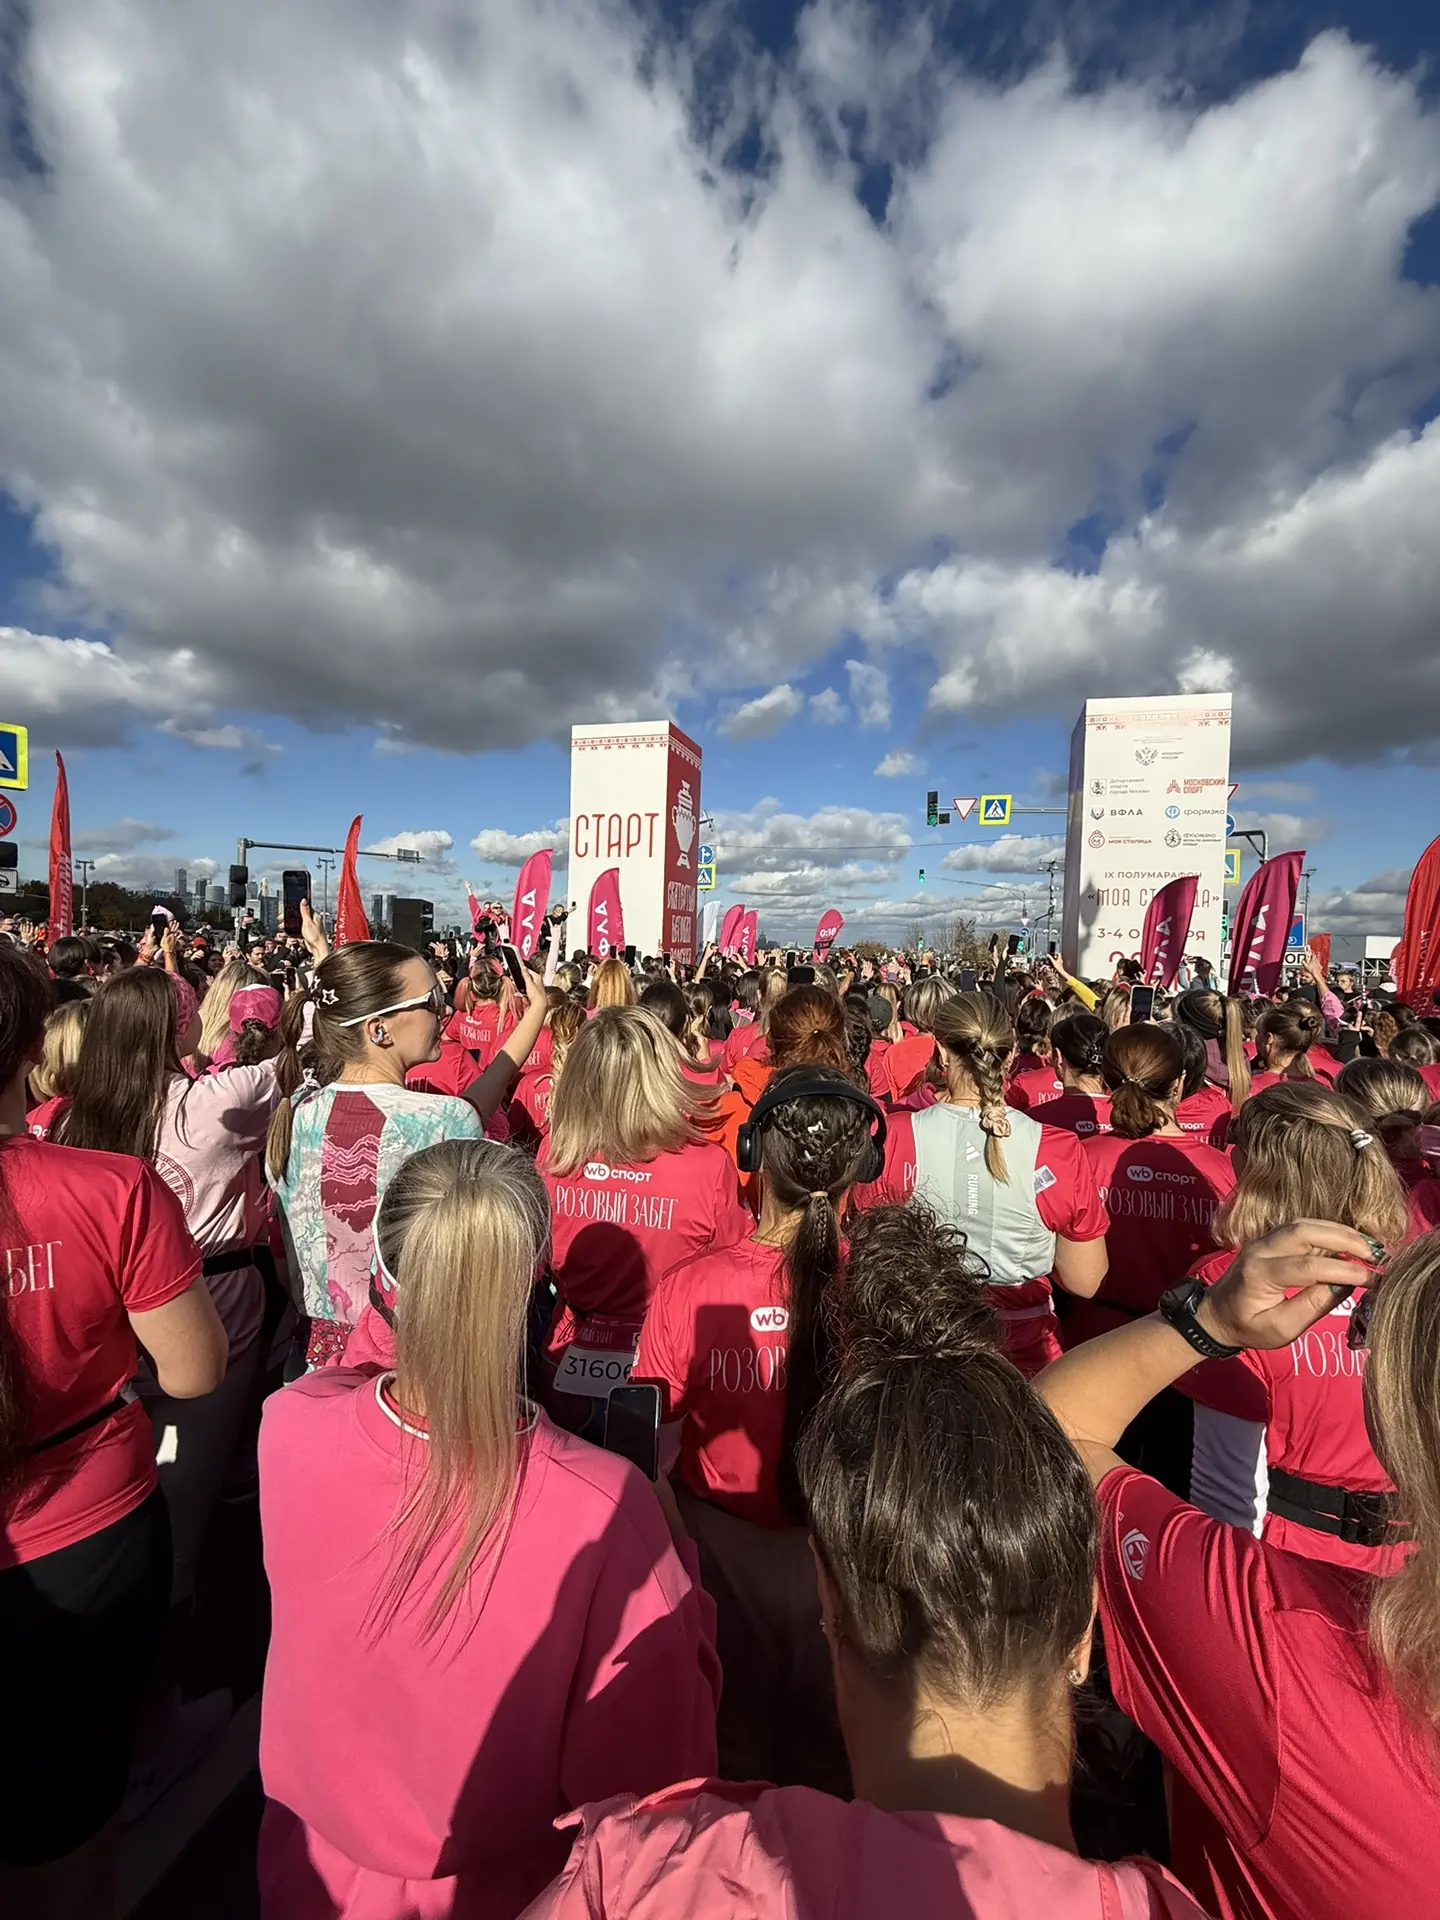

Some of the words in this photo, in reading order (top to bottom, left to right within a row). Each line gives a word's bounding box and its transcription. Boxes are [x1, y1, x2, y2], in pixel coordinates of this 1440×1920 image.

[1183, 777, 1226, 786] МОСКОВСКИЙ
[1183, 786, 1203, 794] СПОРТ
[1110, 808, 1144, 817] ВФЛА
[1183, 809, 1225, 817] формэко
[575, 813, 659, 858] СТАРТ
[1117, 871, 1203, 879] ПОЛУМАРАФОН
[521, 888, 537, 957] ФЛА
[594, 900, 611, 957] ФЛА
[1097, 928, 1123, 939] 3-4
[1095, 1123, 1114, 1131] спо
[1179, 1122, 1205, 1131] порт
[585, 1163, 607, 1178] wb
[610, 1169, 653, 1184] спорт
[1129, 1167, 1151, 1179] wb
[1154, 1171, 1197, 1186] спорт
[967, 1173, 980, 1216] RUNNING
[1099, 1186, 1175, 1221] РОЗОВЫЙ
[556, 1185, 628, 1224] РОЗОВЫЙ
[629, 1194, 679, 1231] ЗАБЕГ
[6, 1240, 63, 1298] БЕГ
[755, 1308, 786, 1327] wb
[710, 1345, 788, 1394] РОЗОВ
